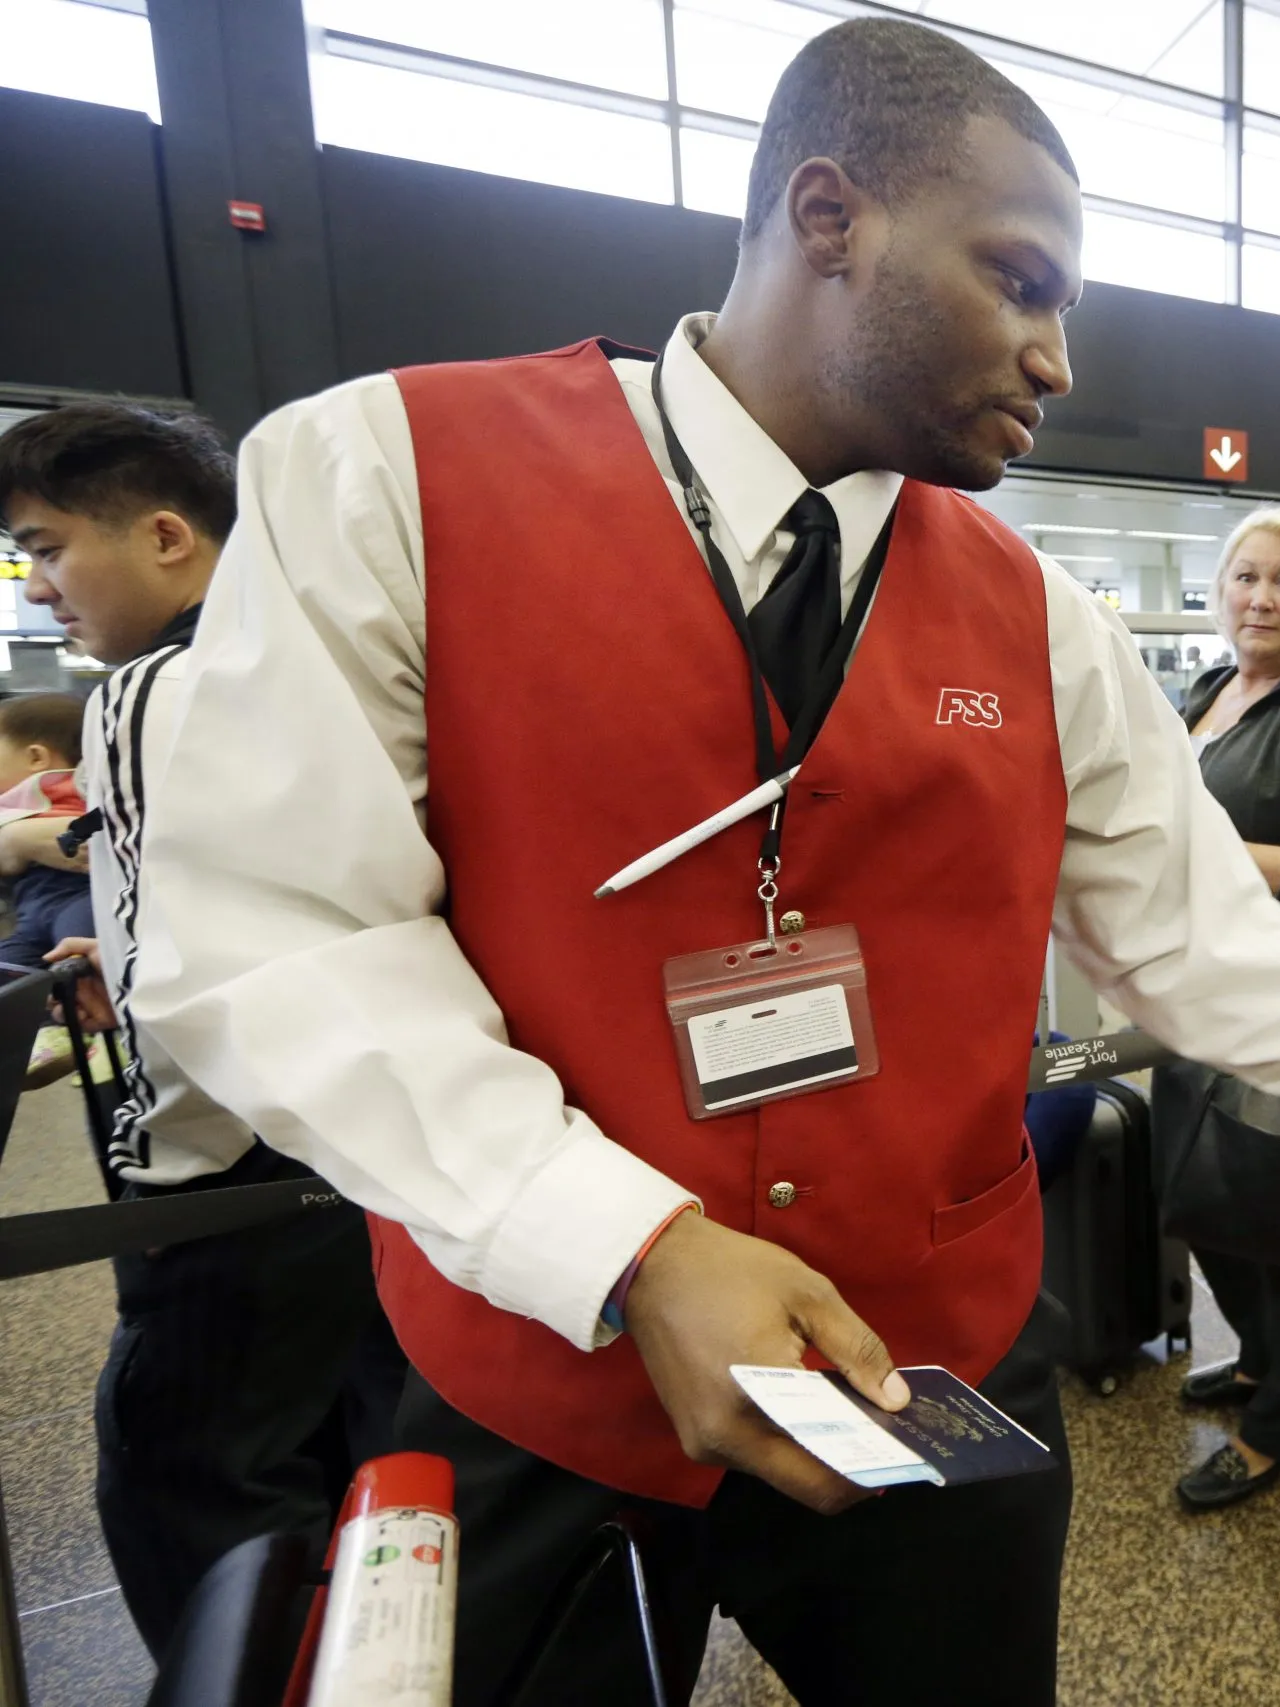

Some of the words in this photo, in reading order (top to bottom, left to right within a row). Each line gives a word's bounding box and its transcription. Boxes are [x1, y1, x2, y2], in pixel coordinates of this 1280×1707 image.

[937, 688, 1002, 728] FSS
[1044, 1042, 1092, 1060] Seattle
[1093, 1040, 1105, 1053] of
[1090, 1050, 1118, 1065] Port
[301, 1192, 341, 1205] Por
